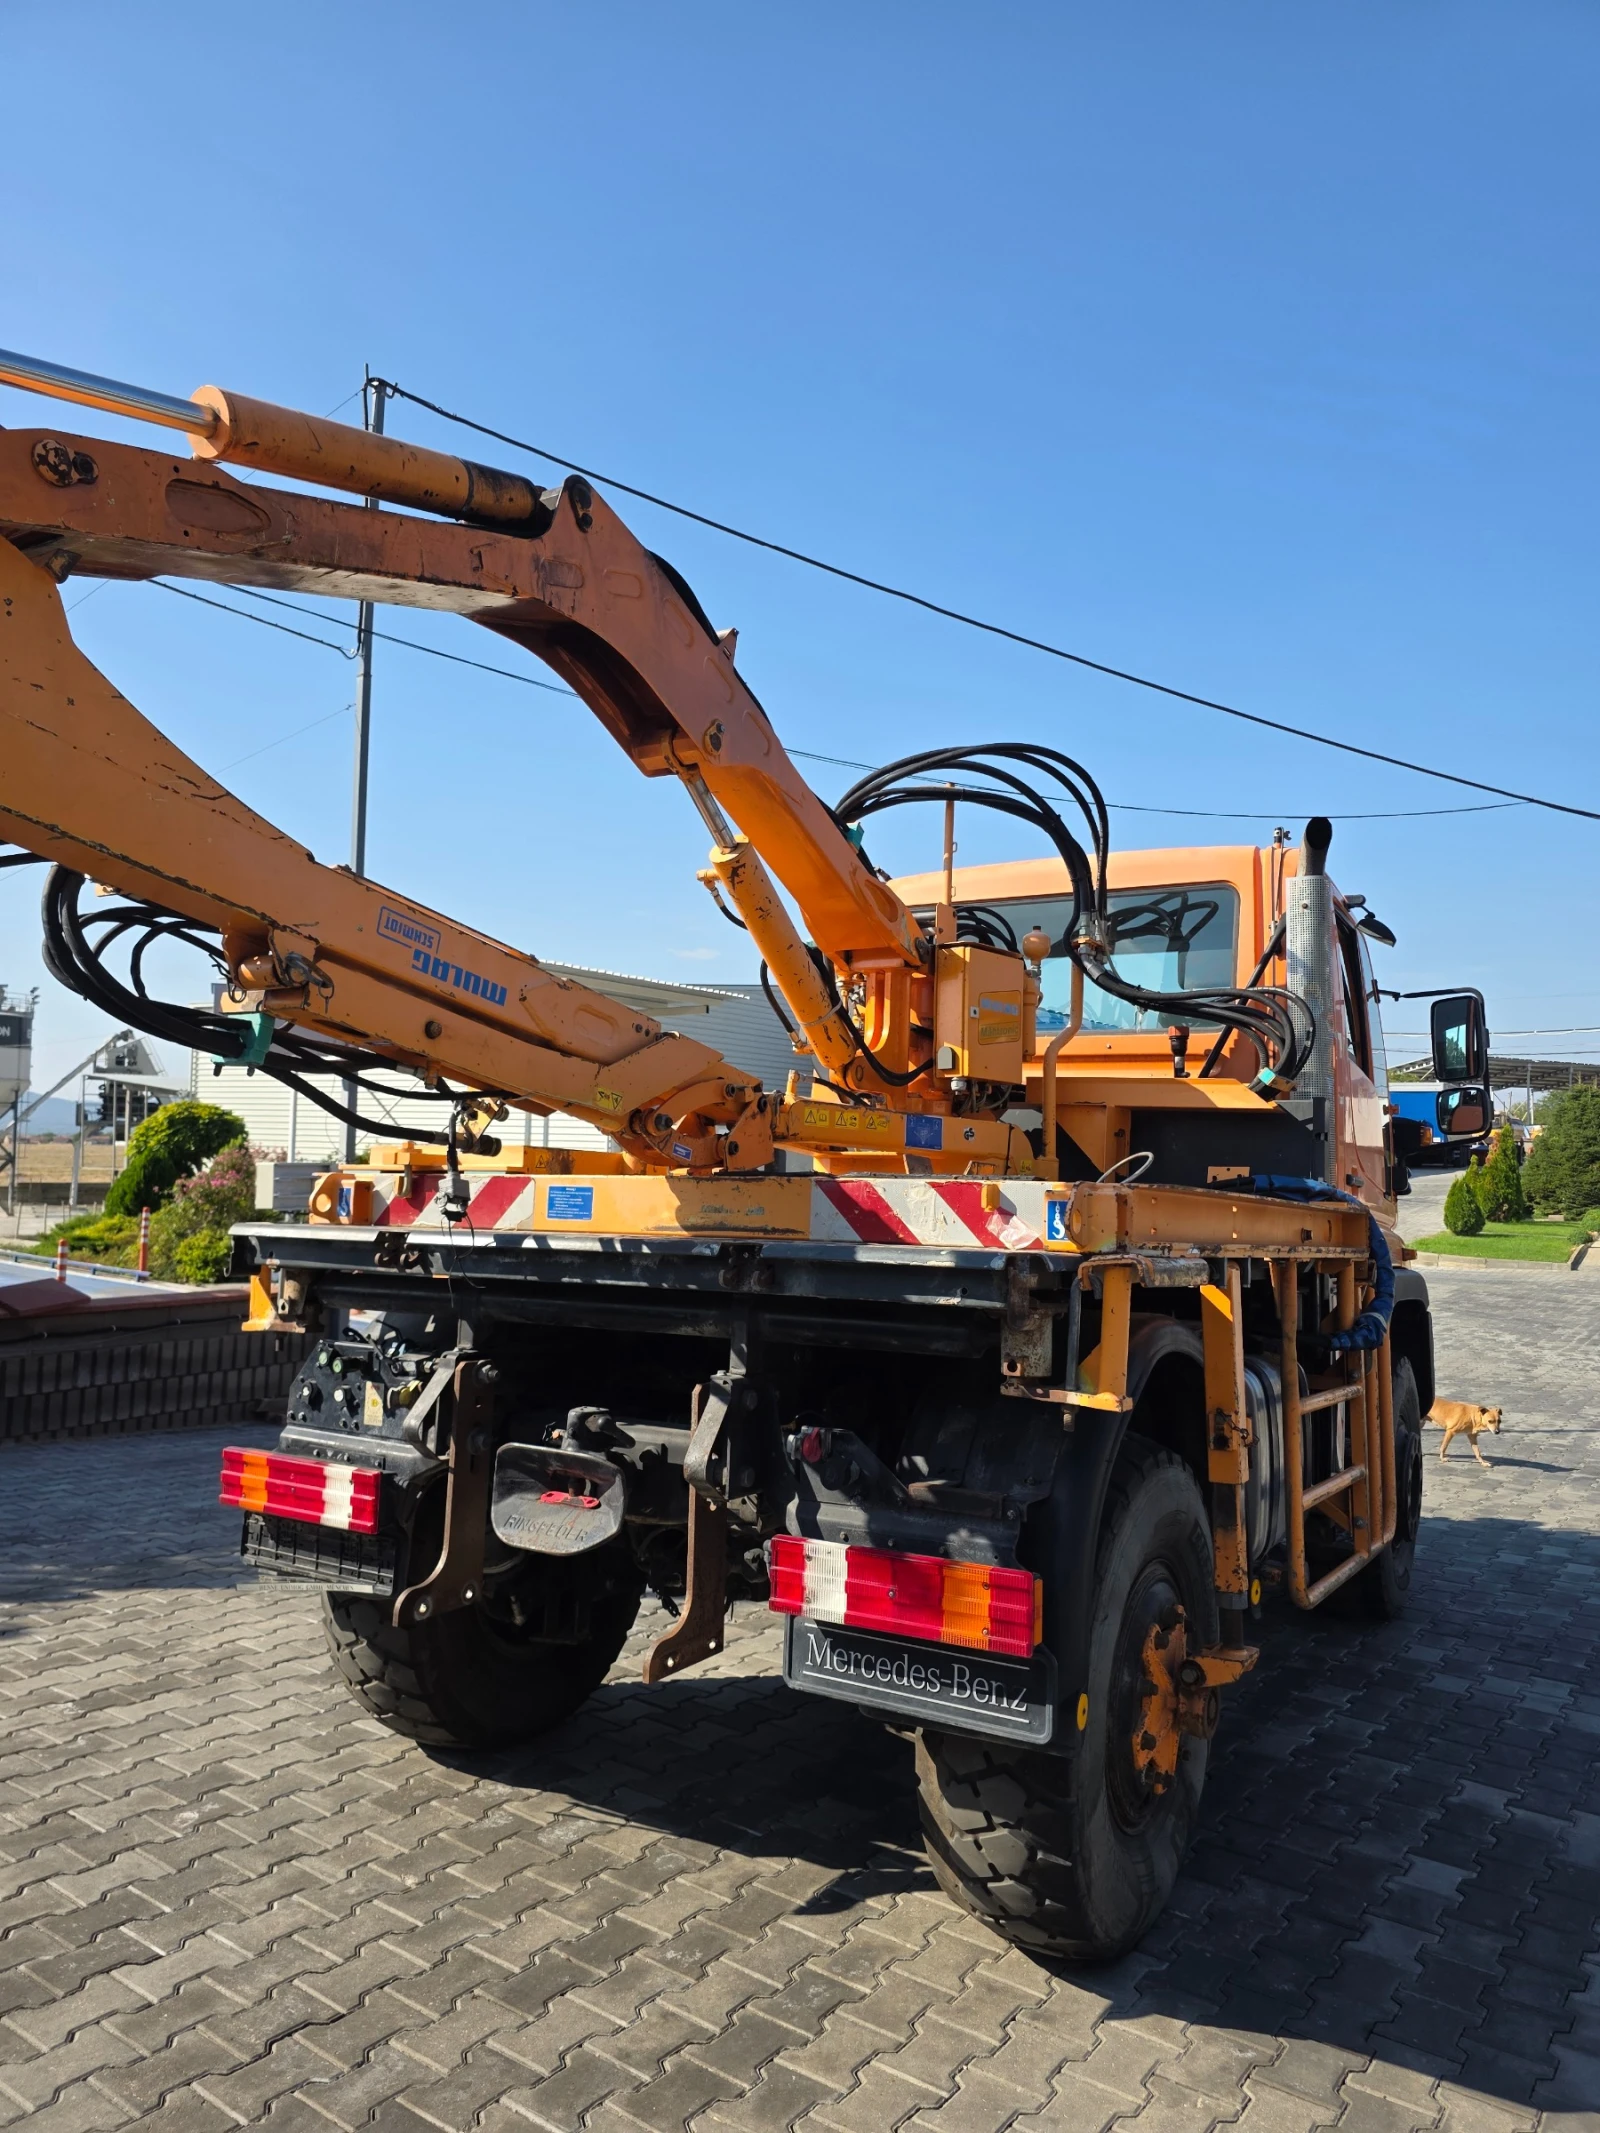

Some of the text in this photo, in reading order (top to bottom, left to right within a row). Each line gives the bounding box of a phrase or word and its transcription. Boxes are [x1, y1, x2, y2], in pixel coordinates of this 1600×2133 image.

[384, 916, 434, 949] SCHMIDT
[412, 948, 507, 1007] MULAG
[503, 1515, 588, 1541] RINGFEDER
[805, 1633, 1028, 1712] Mercedes-Benz
